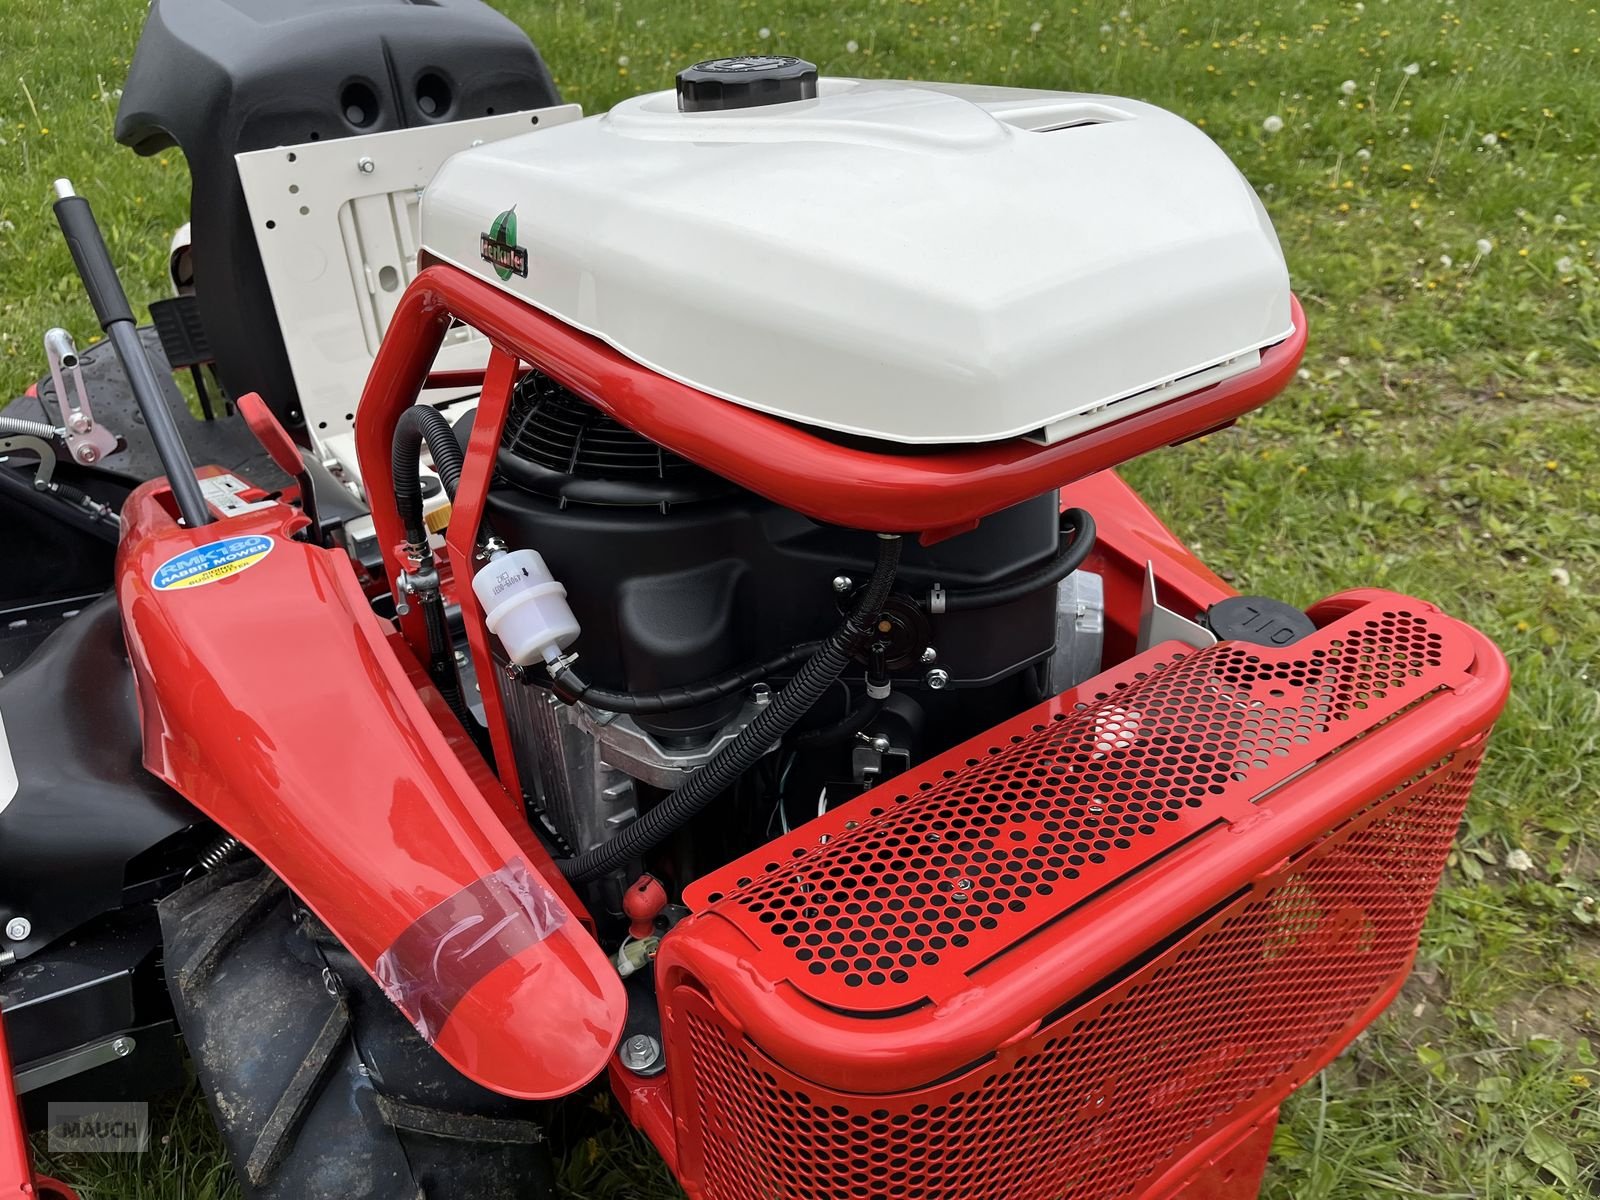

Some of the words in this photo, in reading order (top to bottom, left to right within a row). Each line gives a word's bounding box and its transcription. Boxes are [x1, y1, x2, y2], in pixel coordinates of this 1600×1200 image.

[159, 537, 261, 577] RMK180
[161, 561, 210, 585] RABBIT
[213, 543, 268, 567] MOWER
